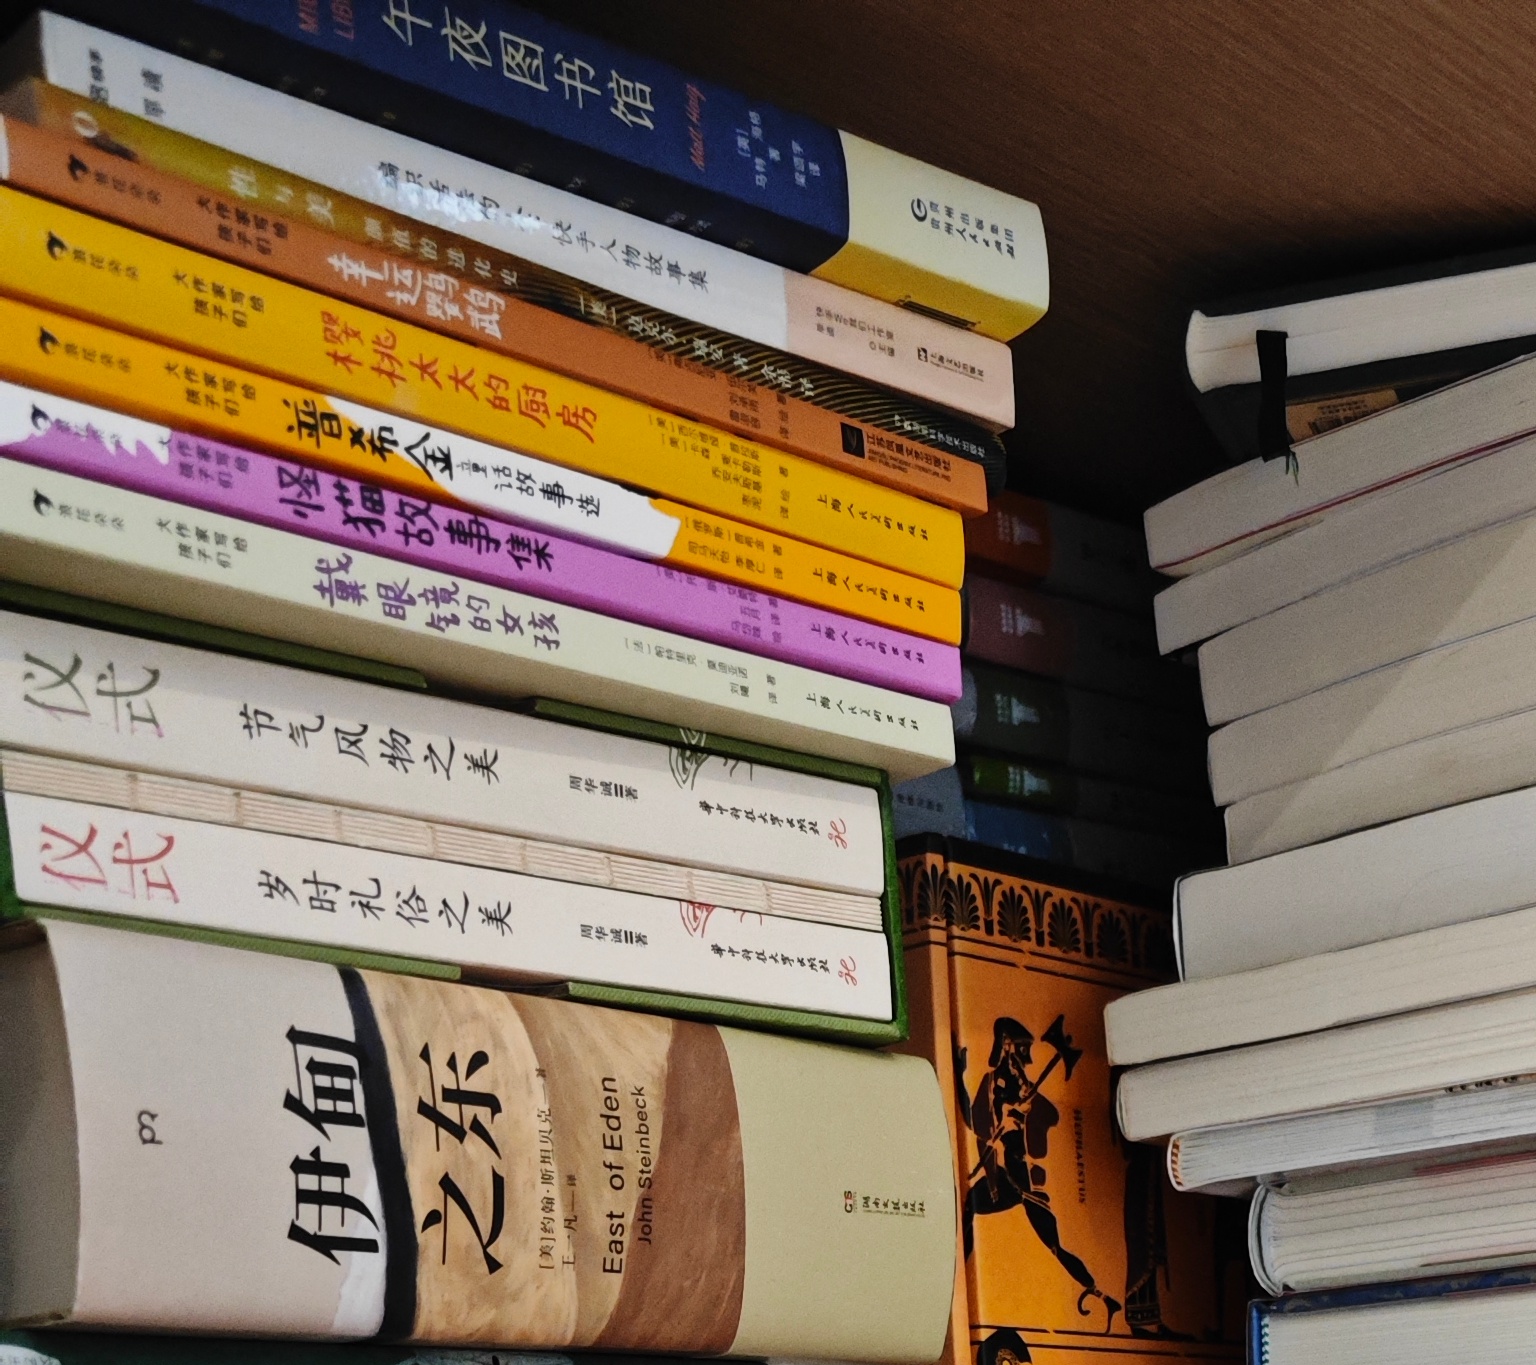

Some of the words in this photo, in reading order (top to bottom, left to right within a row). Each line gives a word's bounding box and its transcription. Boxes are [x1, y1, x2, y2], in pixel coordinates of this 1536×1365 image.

[327, 251, 506, 339] 幸运鹦鹉
[320, 310, 598, 444] 樱桃太太的厨房
[278, 465, 554, 573] 怪猫故事集
[313, 551, 562, 652] 戴眼镜的女孩
[22, 650, 165, 740] 仪式
[238, 702, 501, 787] 节气风物之美
[40, 822, 181, 906] 仪式
[256, 869, 514, 936] 岁时礼俗之美
[282, 1023, 383, 1268] 伊甸
[414, 1038, 510, 1276] 之东
[601, 1074, 622, 1154] Eden
[630, 1083, 653, 1184] Steinbeck
[608, 1161, 625, 1192] of
[636, 1188, 655, 1246] John
[601, 1211, 626, 1276] East
